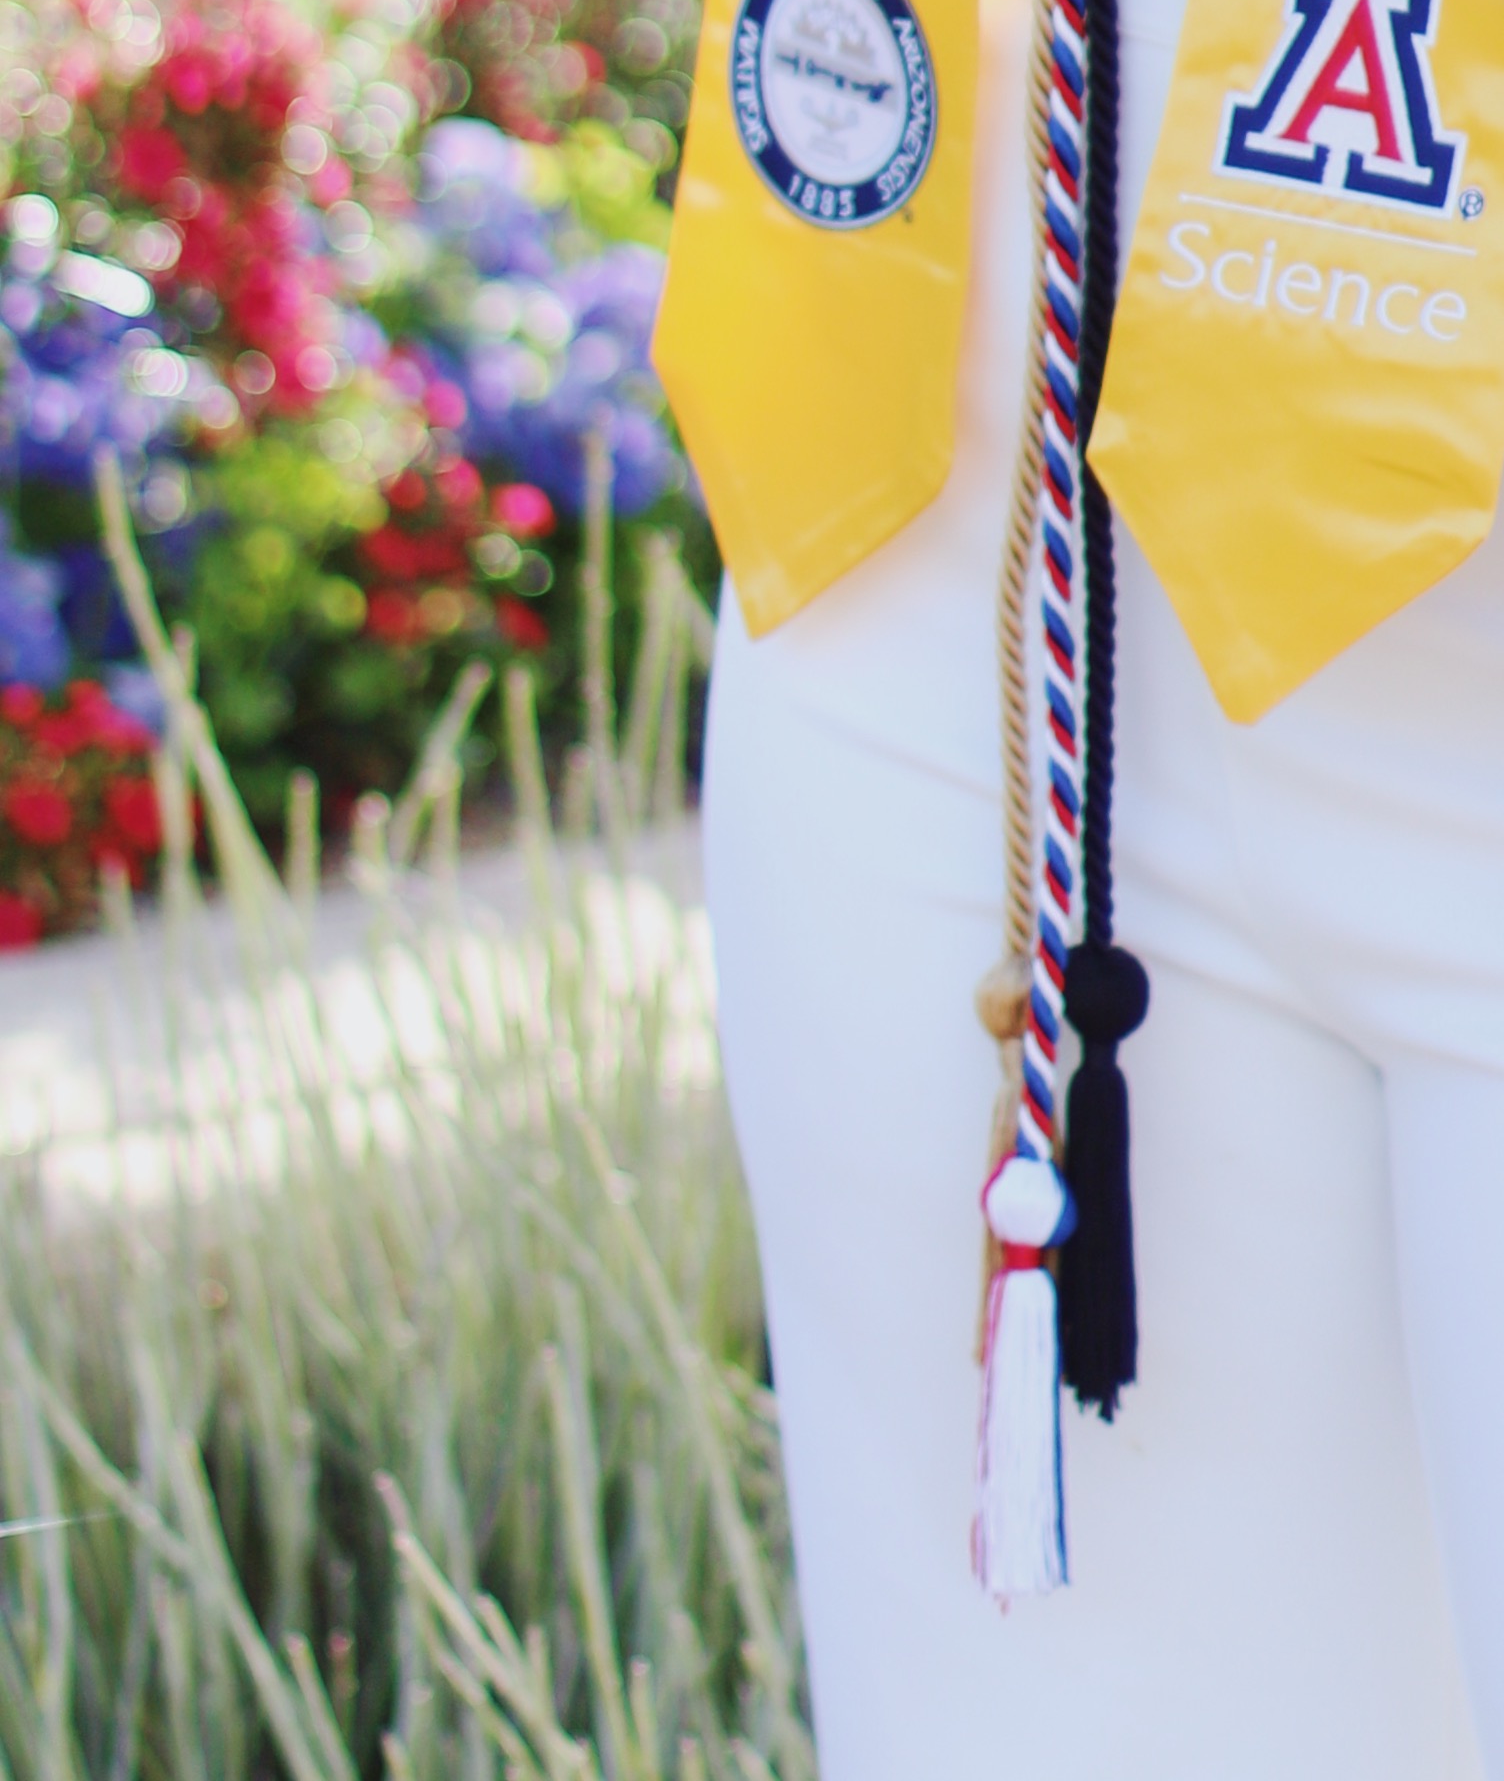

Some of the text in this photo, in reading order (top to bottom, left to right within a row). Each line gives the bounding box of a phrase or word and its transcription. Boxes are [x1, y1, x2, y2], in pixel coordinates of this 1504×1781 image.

[877, 18, 929, 202] ARIZONENSIS
[787, 174, 857, 217] 1885
[1158, 221, 1468, 342] Science
